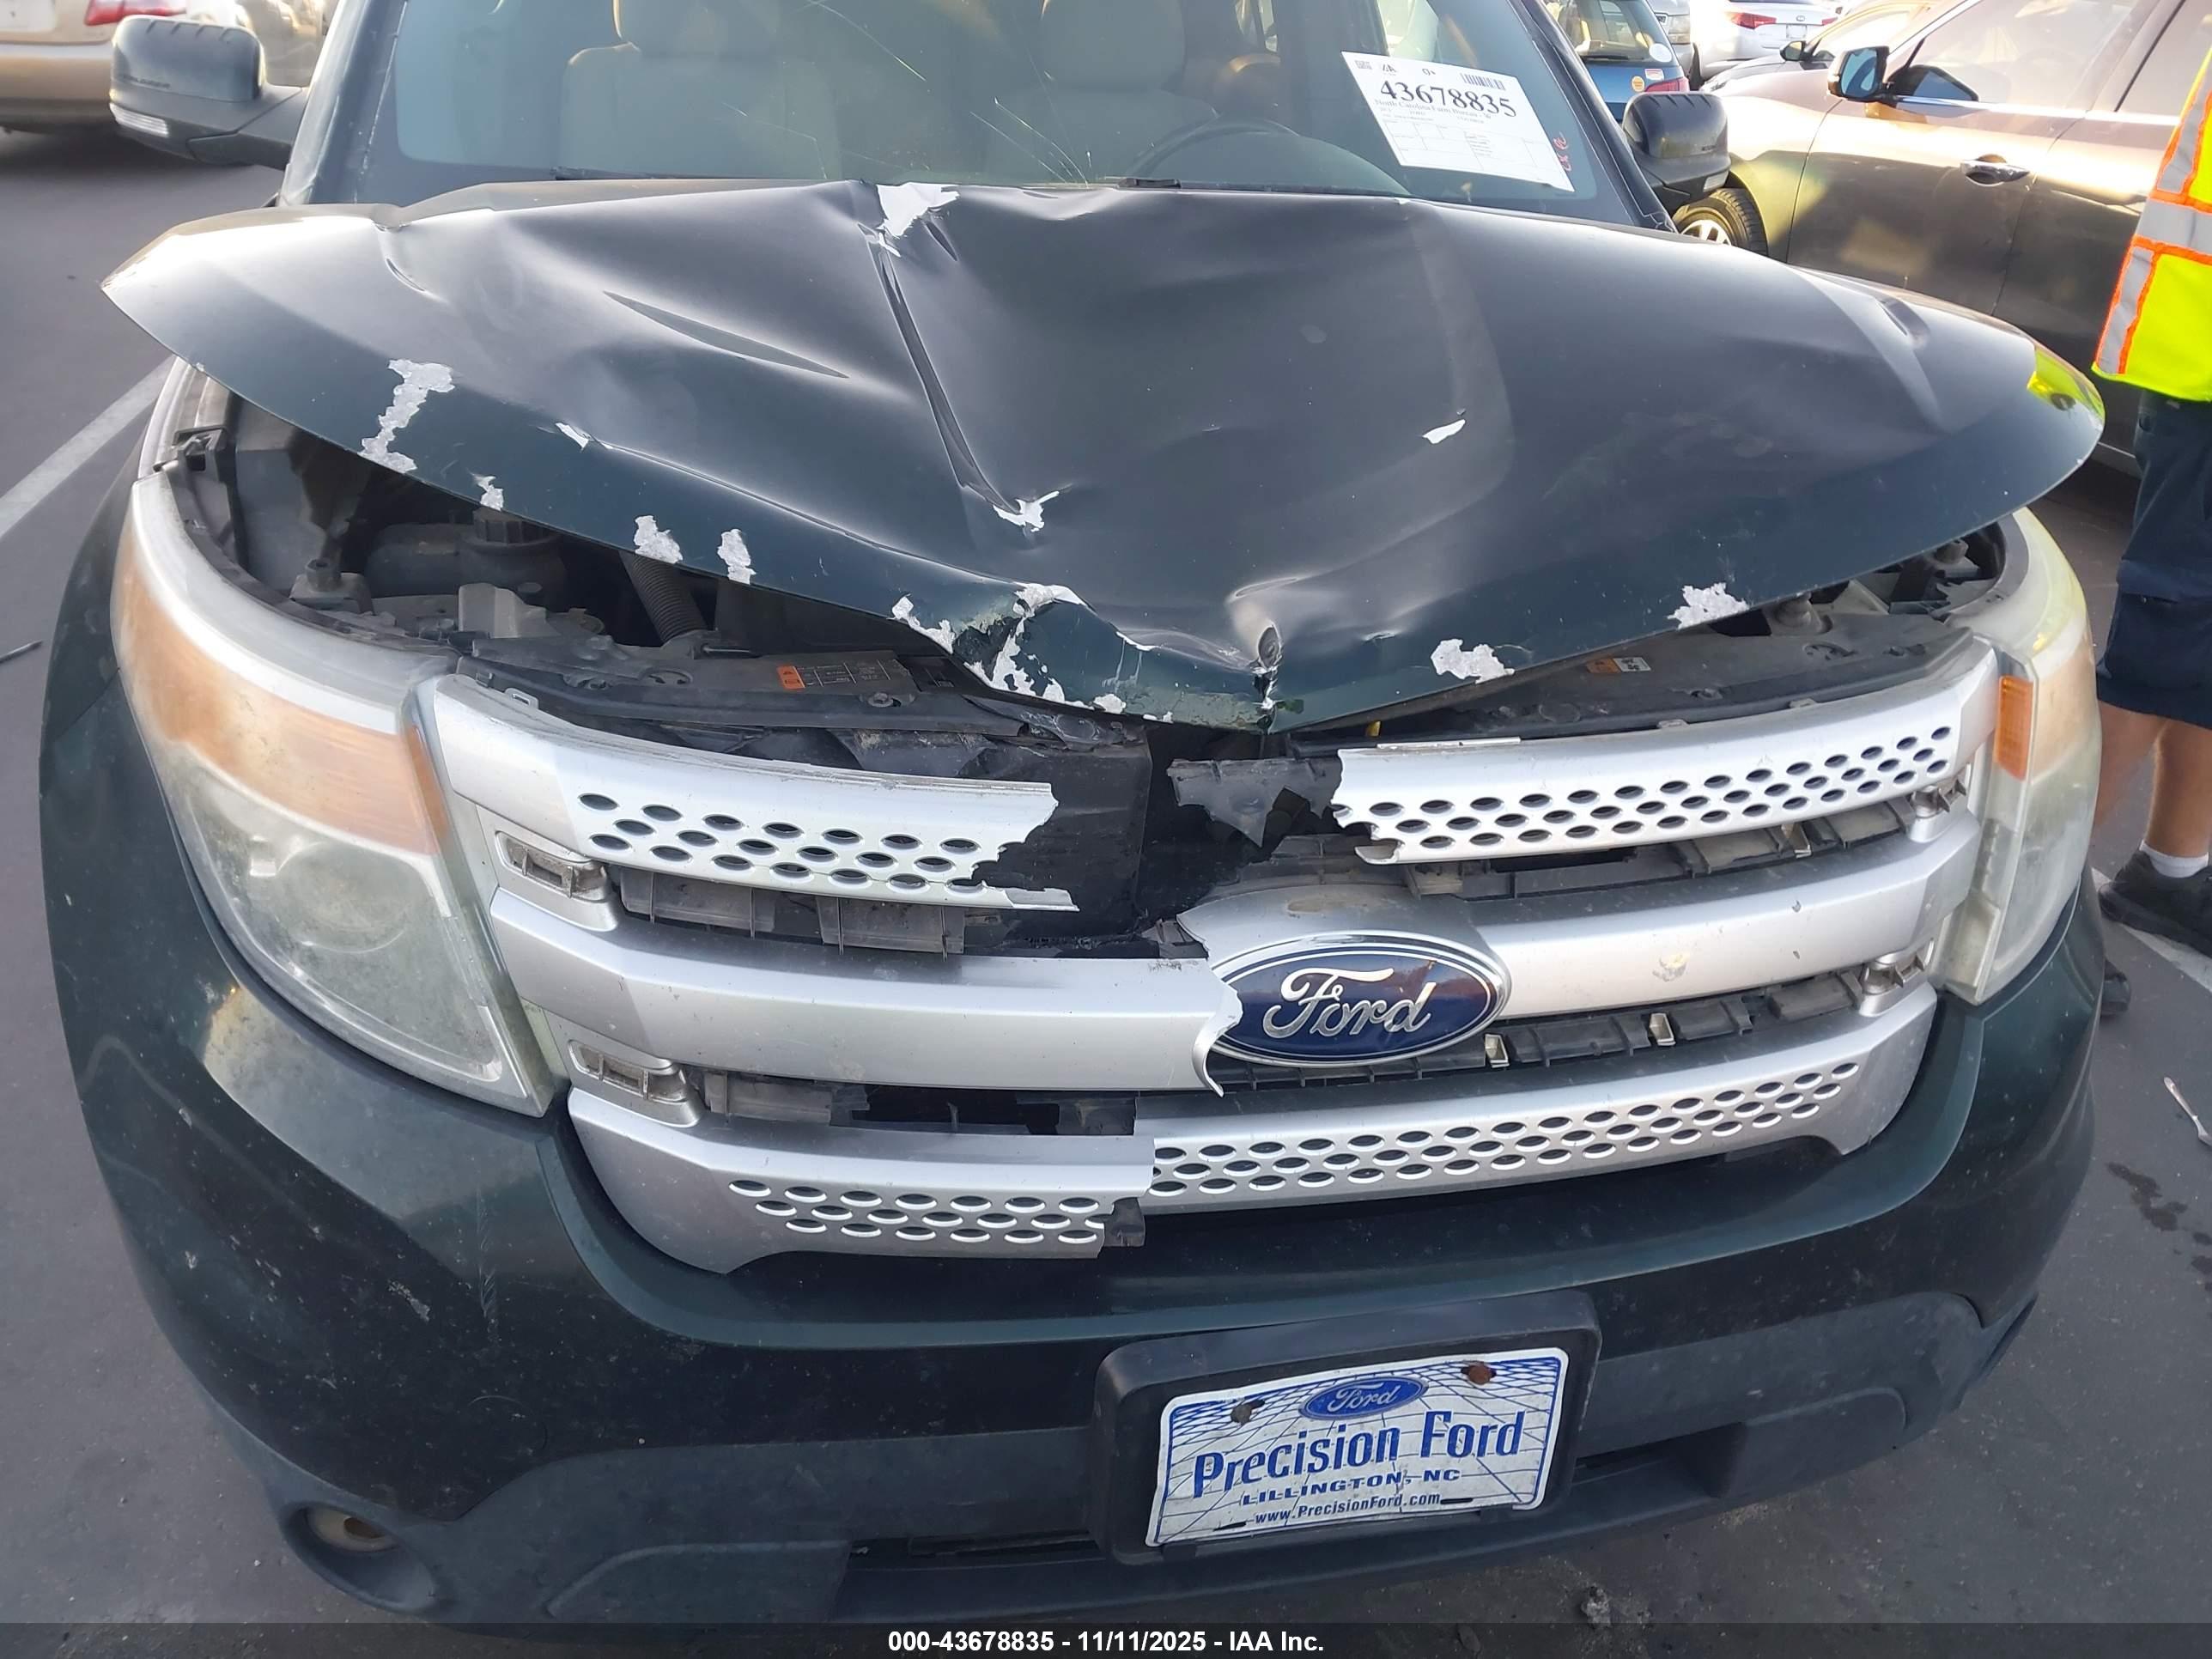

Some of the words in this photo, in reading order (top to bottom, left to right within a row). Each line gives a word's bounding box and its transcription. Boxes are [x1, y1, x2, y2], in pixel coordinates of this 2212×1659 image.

[1381, 80, 1516, 118] 43678835
[1262, 967, 1437, 1038] Ford
[1328, 1382, 1400, 1413] Ford
[1193, 1424, 1401, 1498] Precision
[1420, 1411, 1525, 1458] Ford
[1243, 1471, 1412, 1505] LILLINGTON,
[1423, 1469, 1461, 1481] NC
[1255, 1493, 1441, 1525] www.PrecisionFord.com
